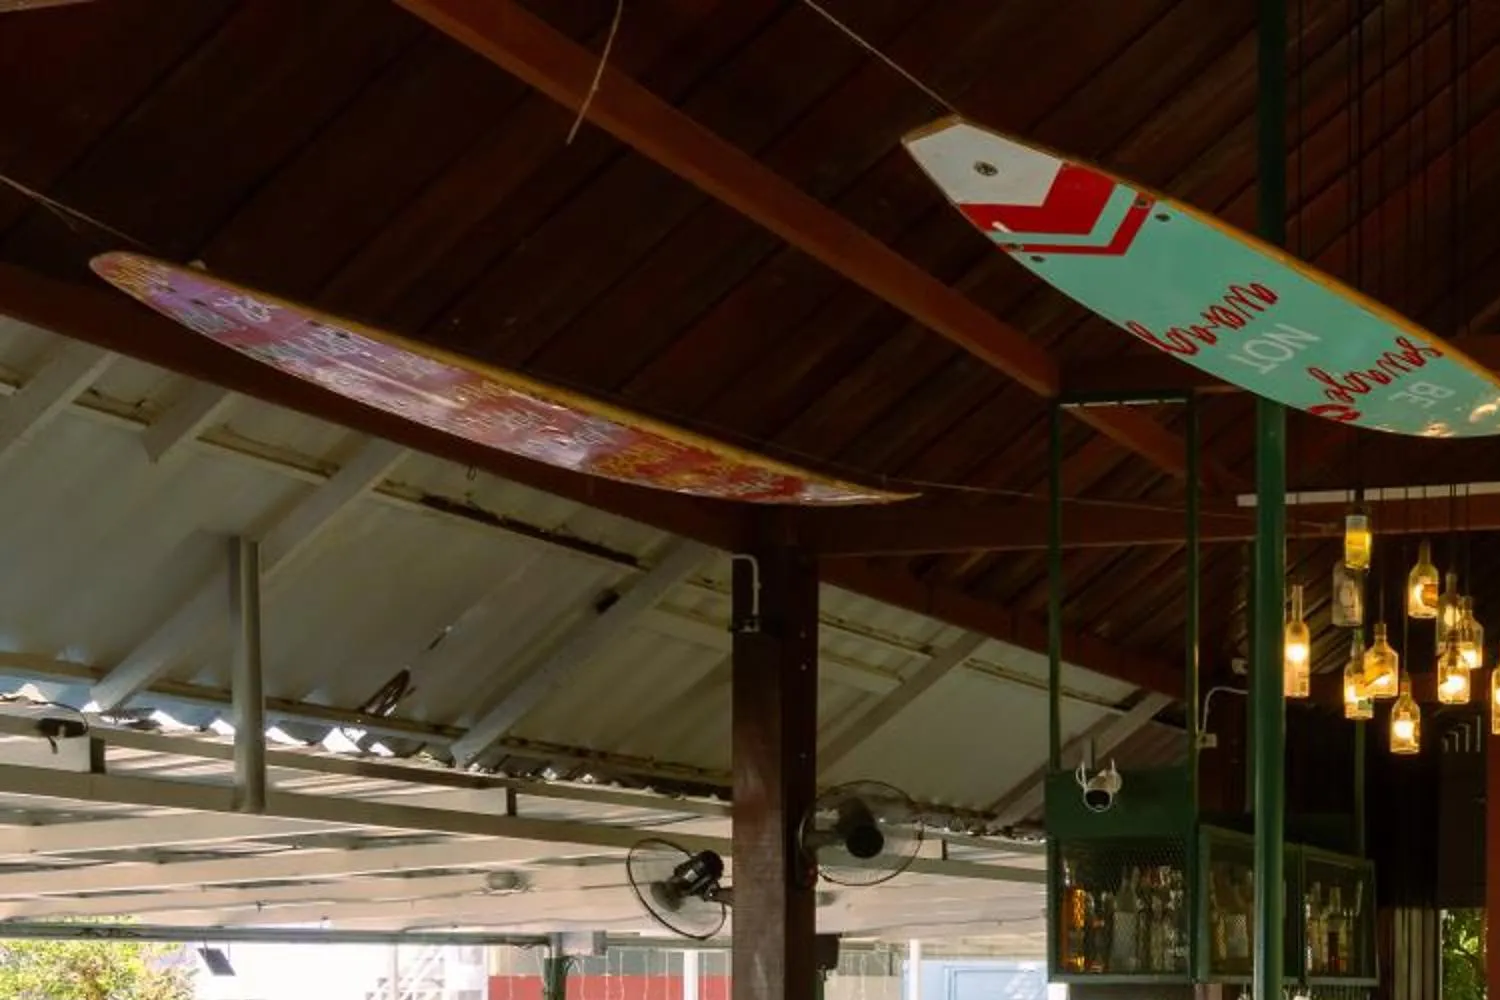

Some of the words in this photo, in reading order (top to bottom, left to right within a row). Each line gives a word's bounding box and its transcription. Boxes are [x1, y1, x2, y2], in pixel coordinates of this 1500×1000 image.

[1126, 283, 1279, 357] averag
[1226, 322, 1321, 375] NOT
[1307, 336, 1443, 404] savage
[1388, 381, 1455, 409] BE
